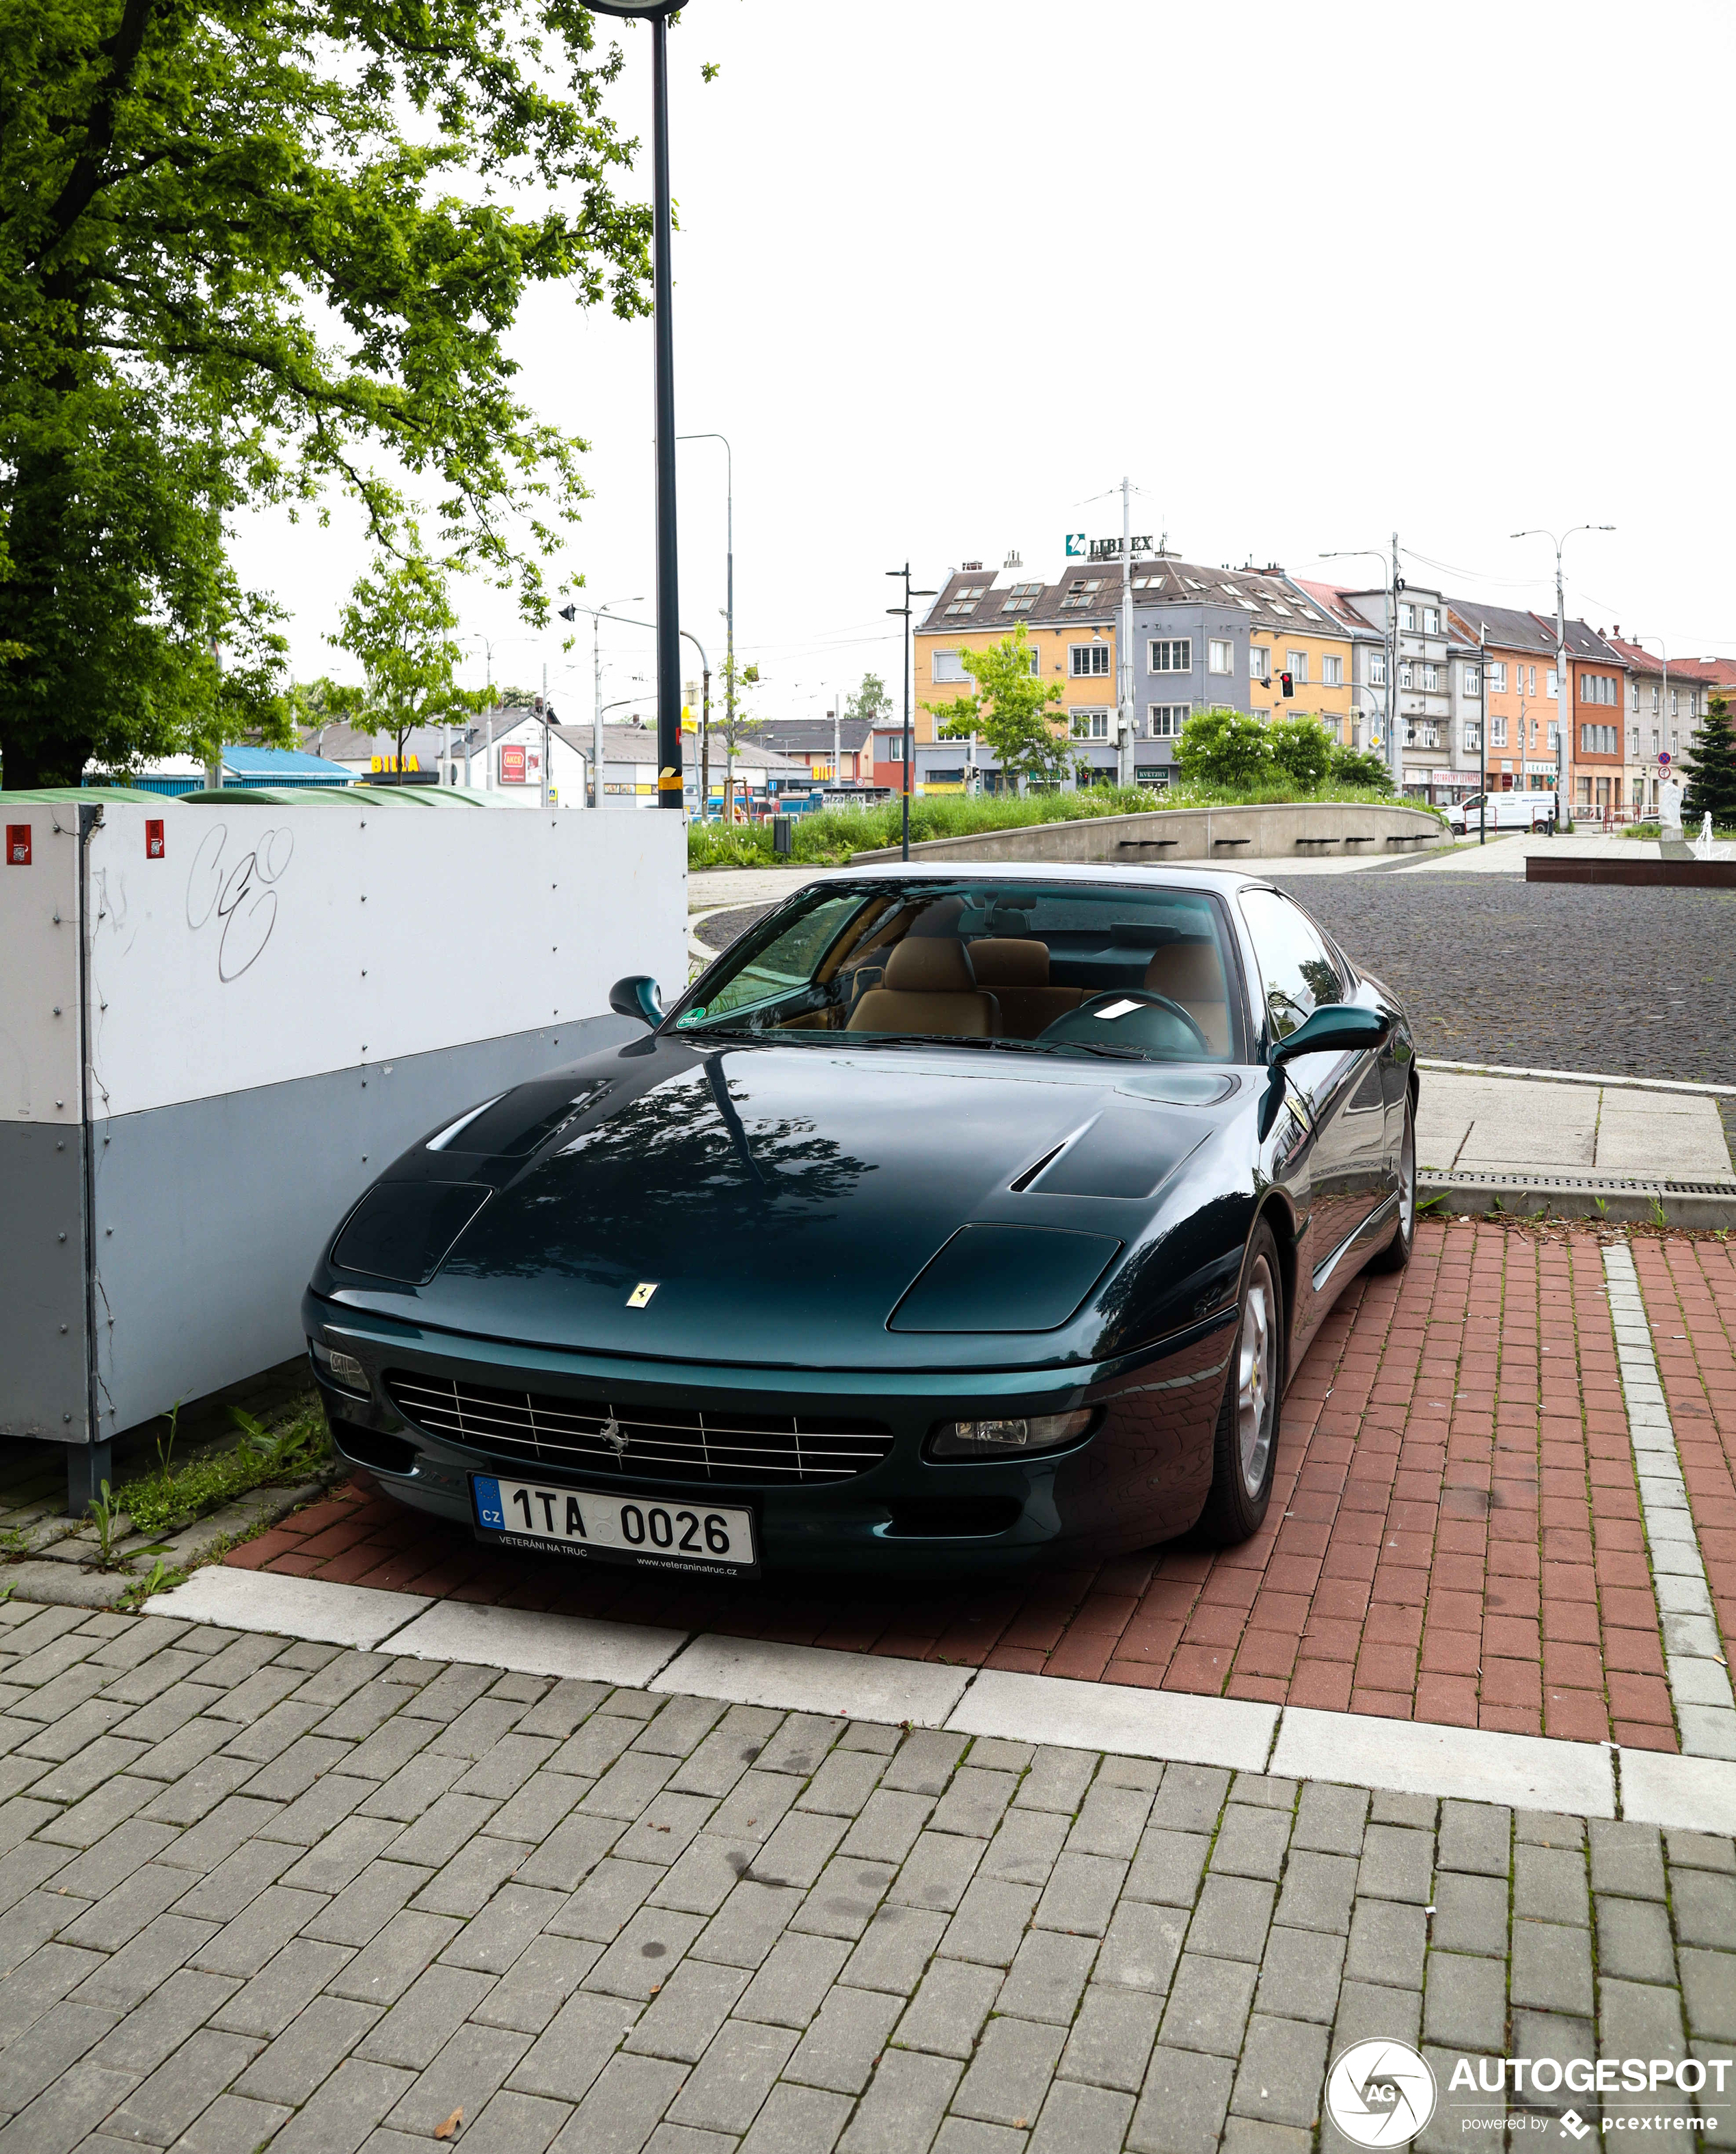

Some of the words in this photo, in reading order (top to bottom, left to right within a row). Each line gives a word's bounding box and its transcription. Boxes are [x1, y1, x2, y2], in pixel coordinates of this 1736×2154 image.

[371, 754, 420, 773] BILLA
[506, 755, 521, 765] AKCE
[811, 766, 836, 781] BILL
[483, 1509, 500, 1523] CZ
[513, 1489, 587, 1537] 1TA
[621, 1505, 730, 1554] 0026
[499, 1535, 545, 1550] VETERÁNI
[547, 1544, 560, 1552] NA
[560, 1546, 587, 1557] TRUC
[637, 1557, 737, 1576] www.veteraninatruc.cz
